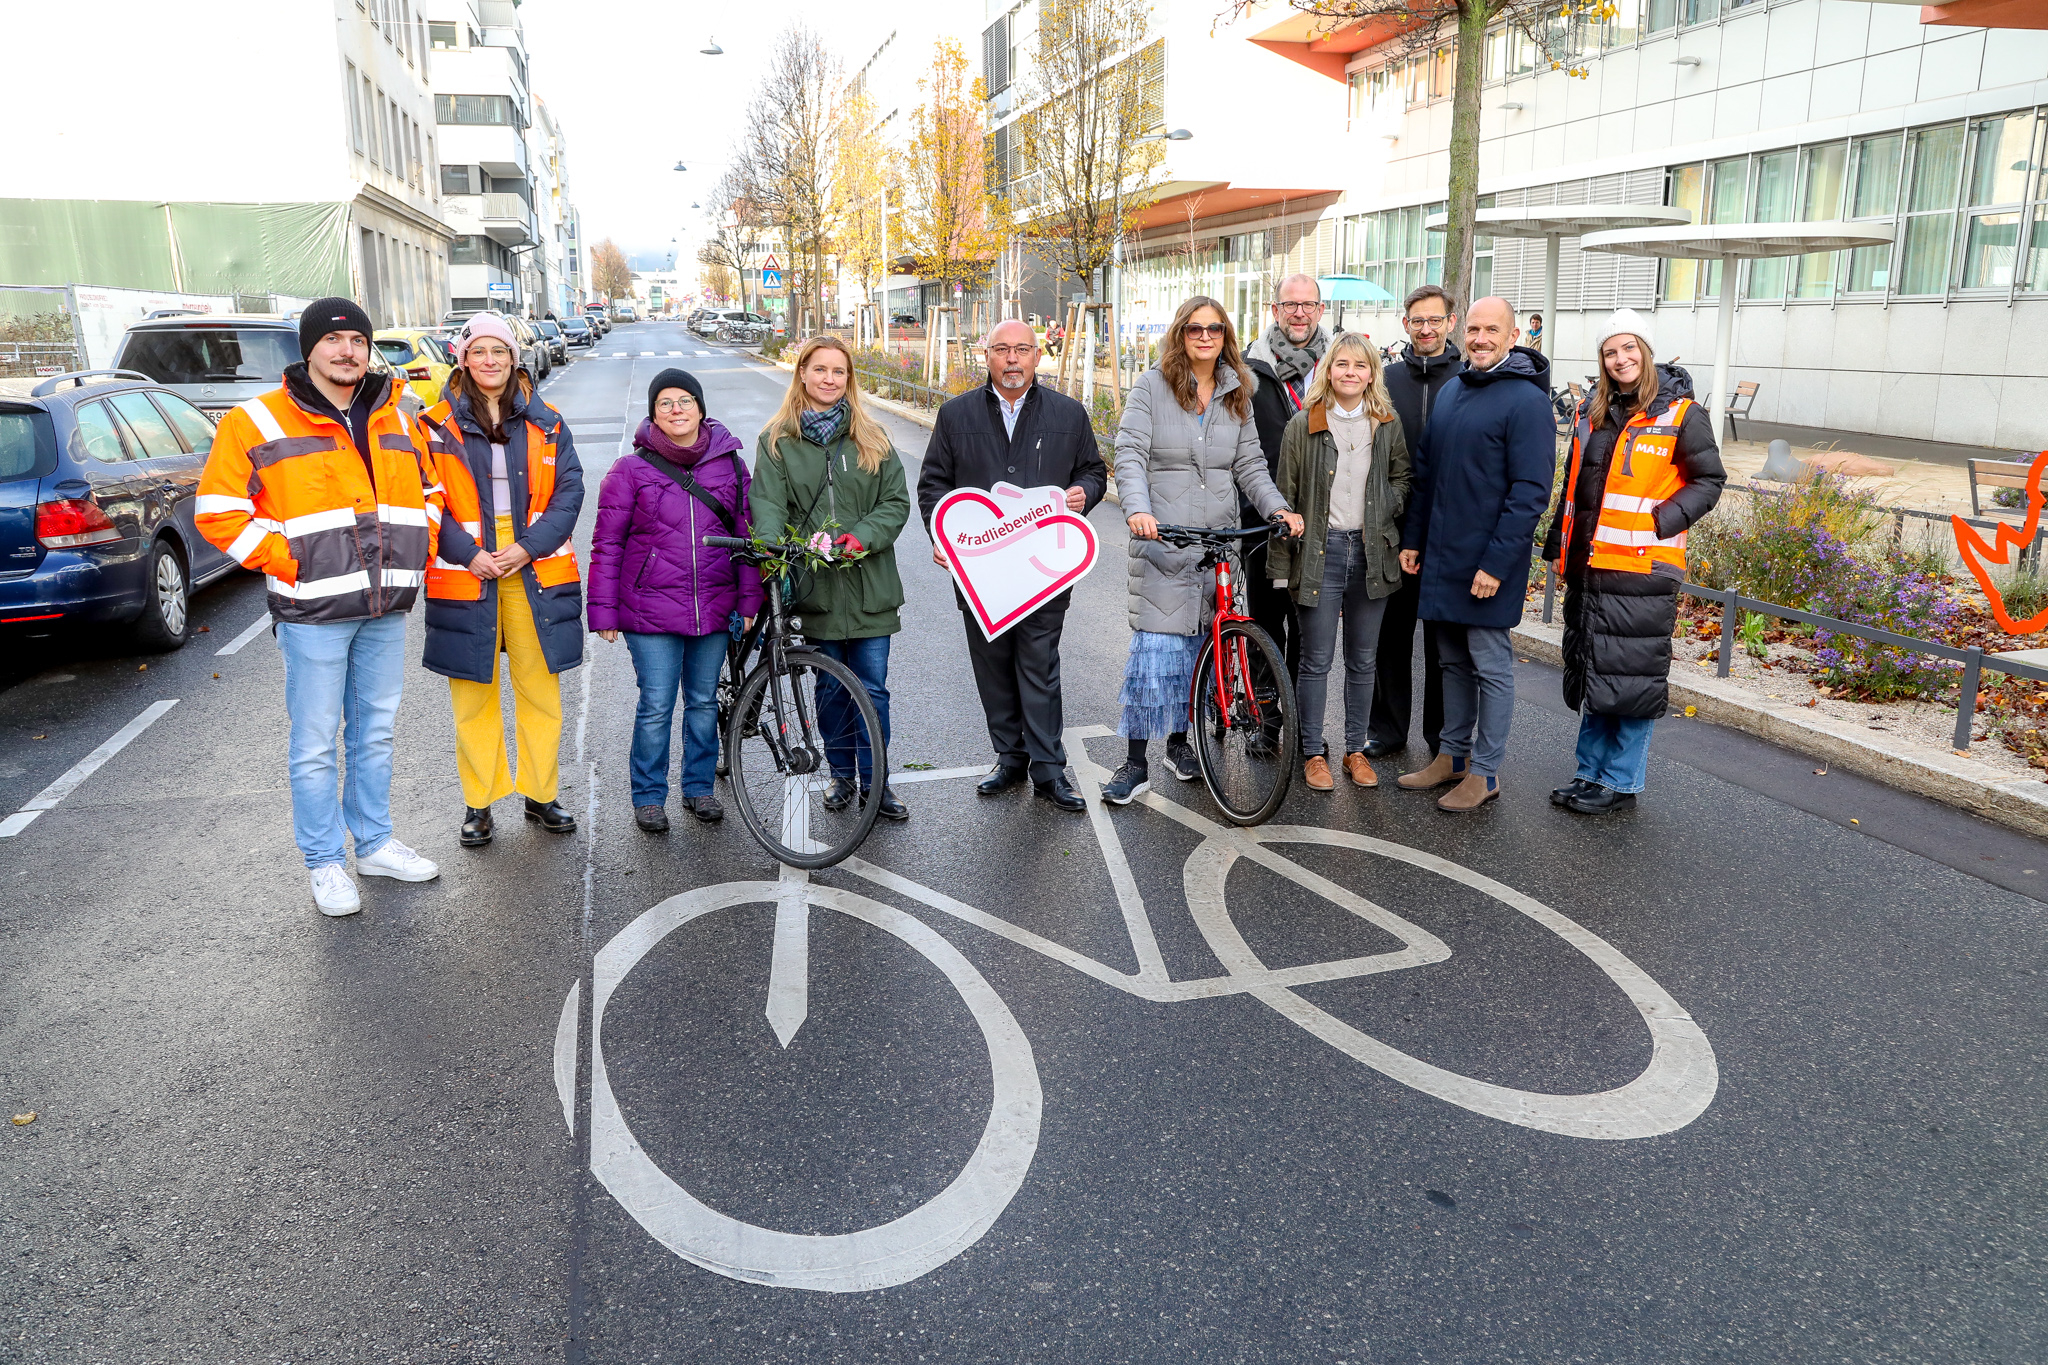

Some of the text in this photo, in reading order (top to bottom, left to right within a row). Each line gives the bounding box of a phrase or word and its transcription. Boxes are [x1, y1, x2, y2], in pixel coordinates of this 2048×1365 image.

[1635, 443, 1669, 457] MA 28
[957, 503, 1053, 546] #radliebewien
